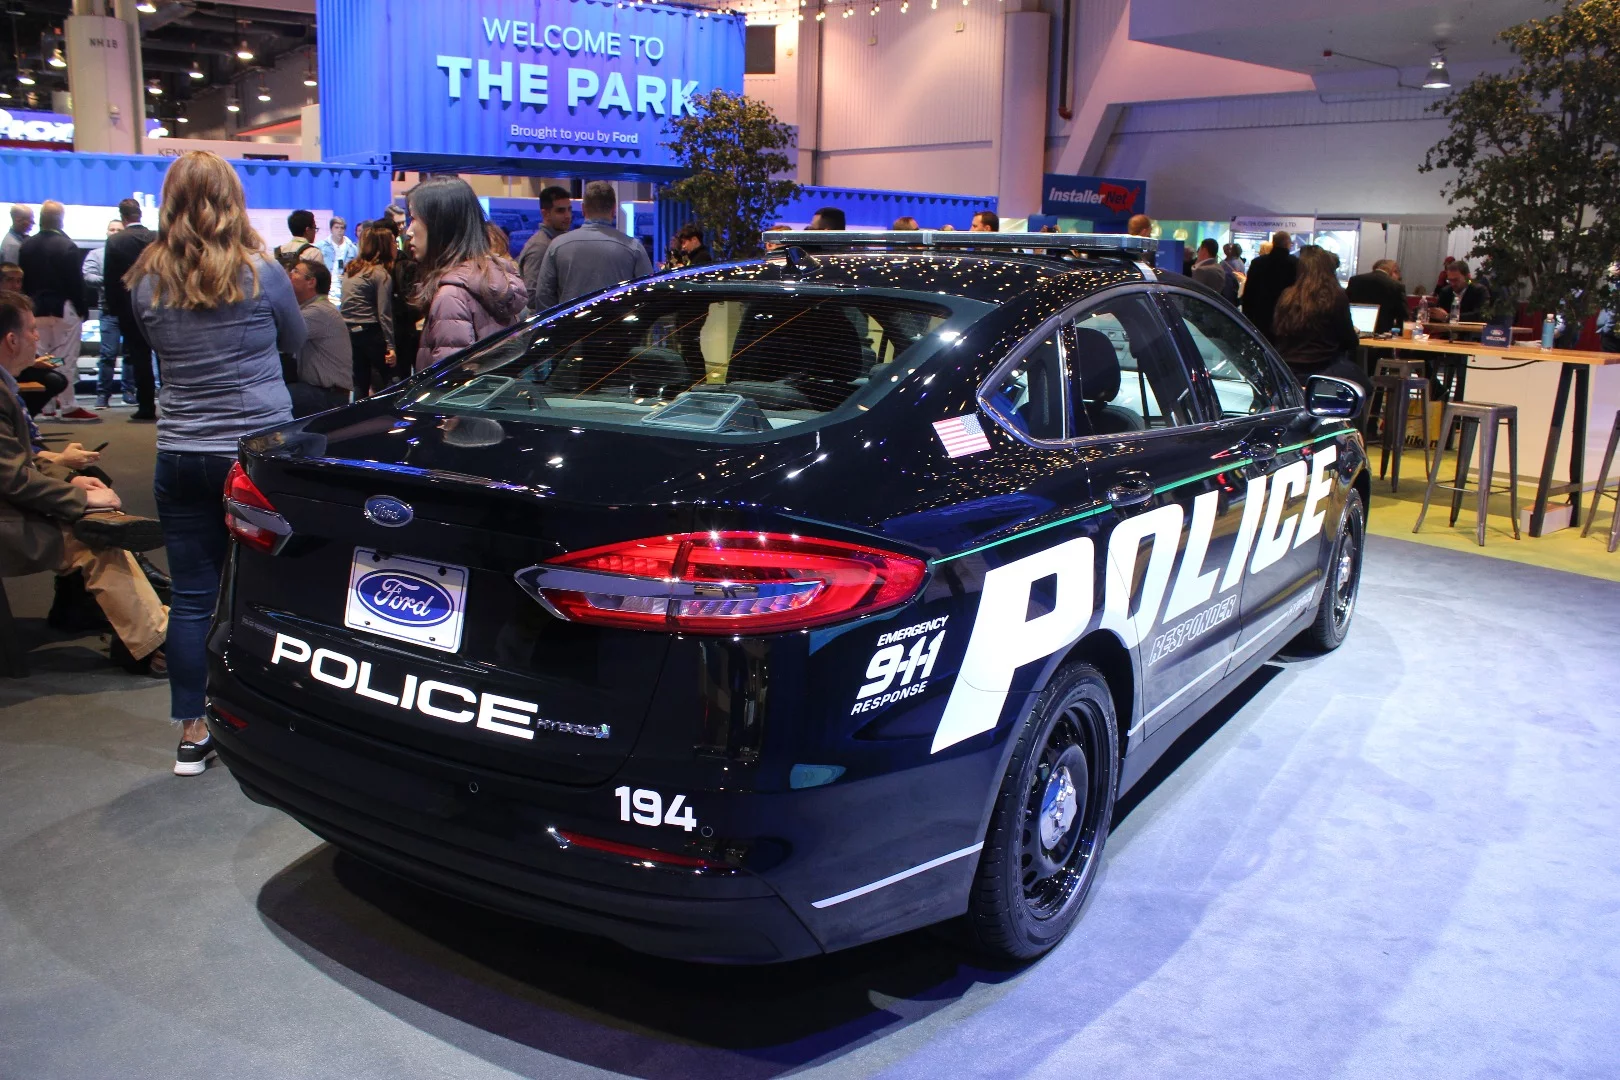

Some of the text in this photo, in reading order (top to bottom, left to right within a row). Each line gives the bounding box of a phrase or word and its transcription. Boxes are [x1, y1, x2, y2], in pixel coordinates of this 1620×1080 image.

[482, 16, 664, 60] WELCOME TO
[436, 54, 699, 116] THE PARK
[510, 124, 638, 143] Brought to you by Ford
[373, 501, 401, 520] Ford
[373, 578, 434, 617] Ford
[930, 445, 1338, 754] POLICE
[876, 615, 950, 646] EMERGENCY
[1147, 594, 1237, 667] RESPONDER
[271, 633, 538, 740] POLICE
[850, 681, 928, 715] RESPONSE
[615, 786, 696, 831] 194
